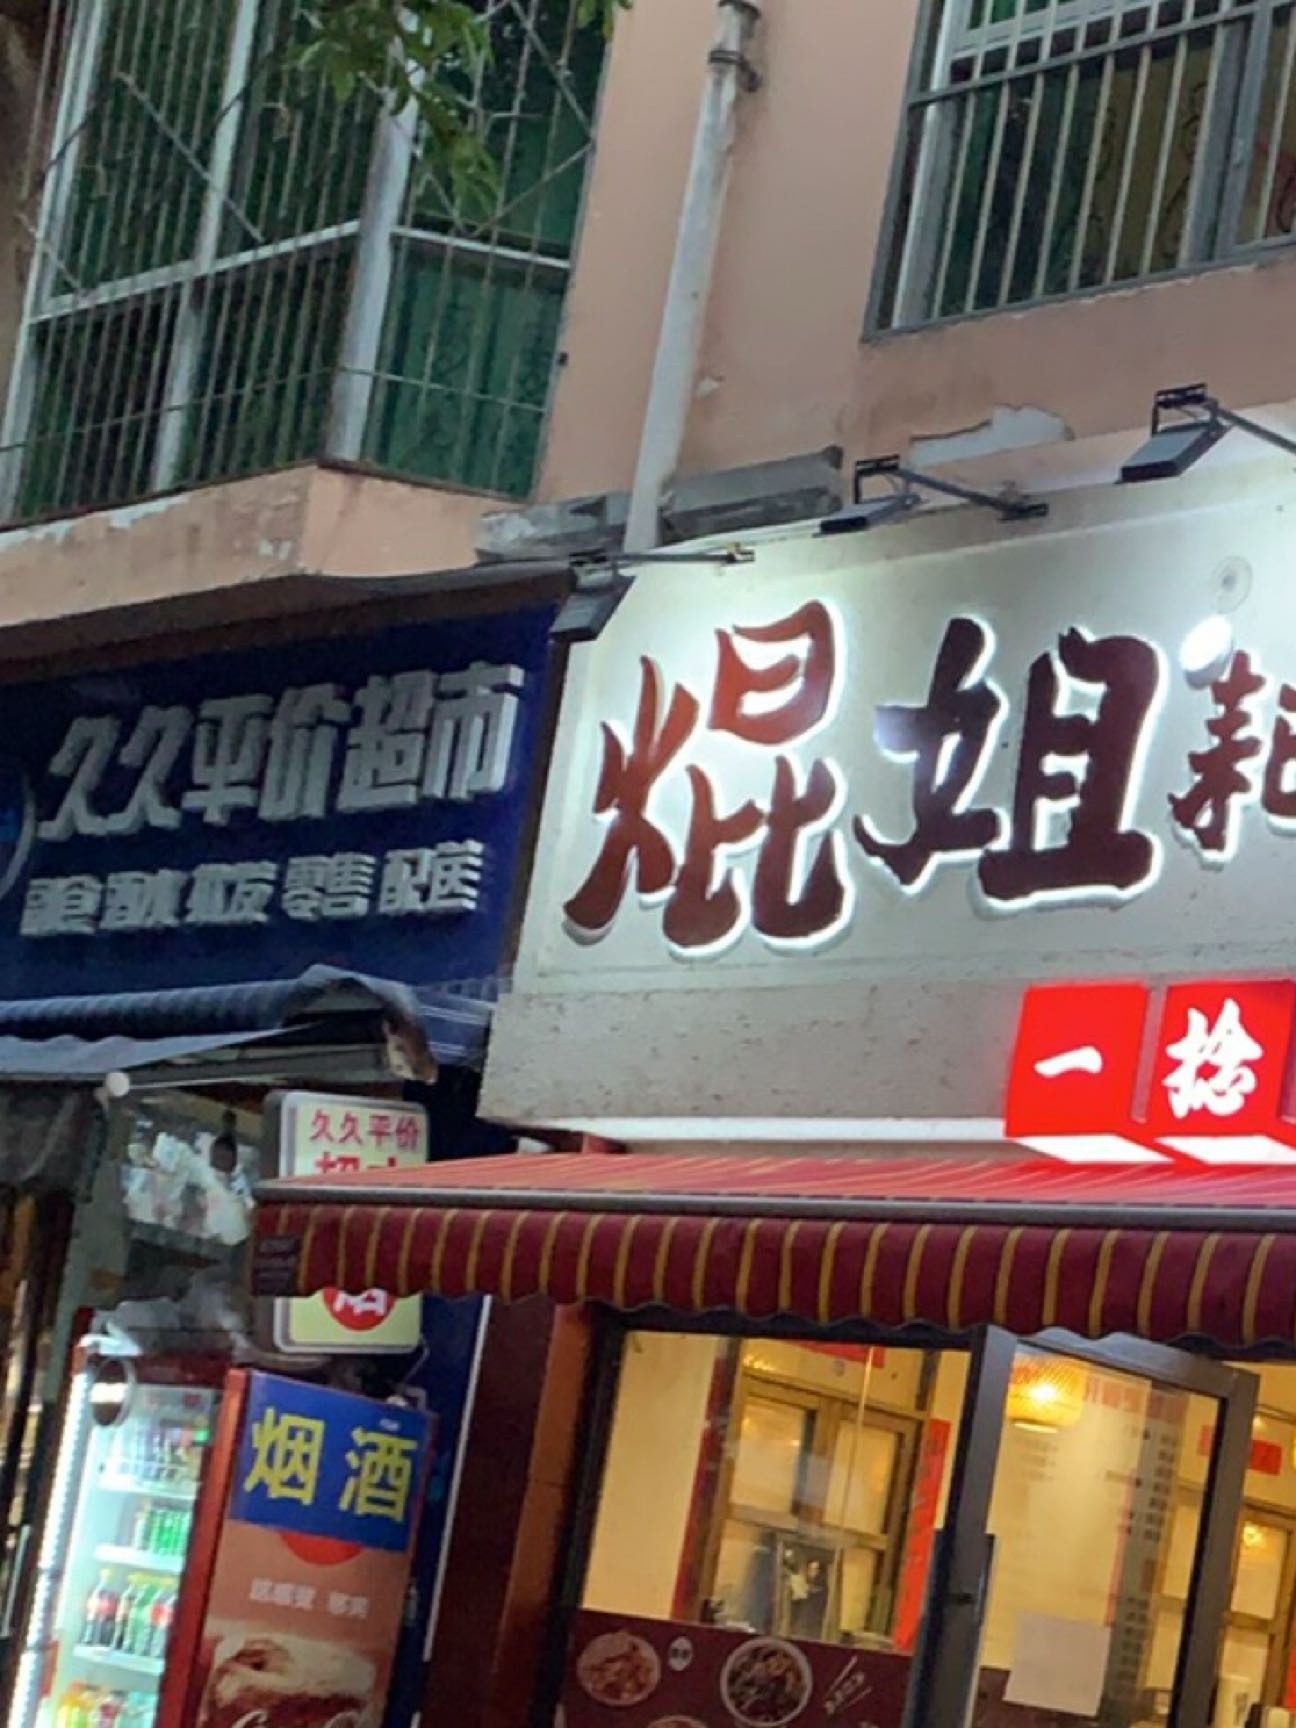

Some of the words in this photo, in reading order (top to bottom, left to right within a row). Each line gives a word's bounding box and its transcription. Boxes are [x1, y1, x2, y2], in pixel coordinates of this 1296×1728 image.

[37, 662, 524, 838] 久久平价超市
[309, 1108, 421, 1153] 久久平价
[243, 1407, 417, 1523] 烟酒
